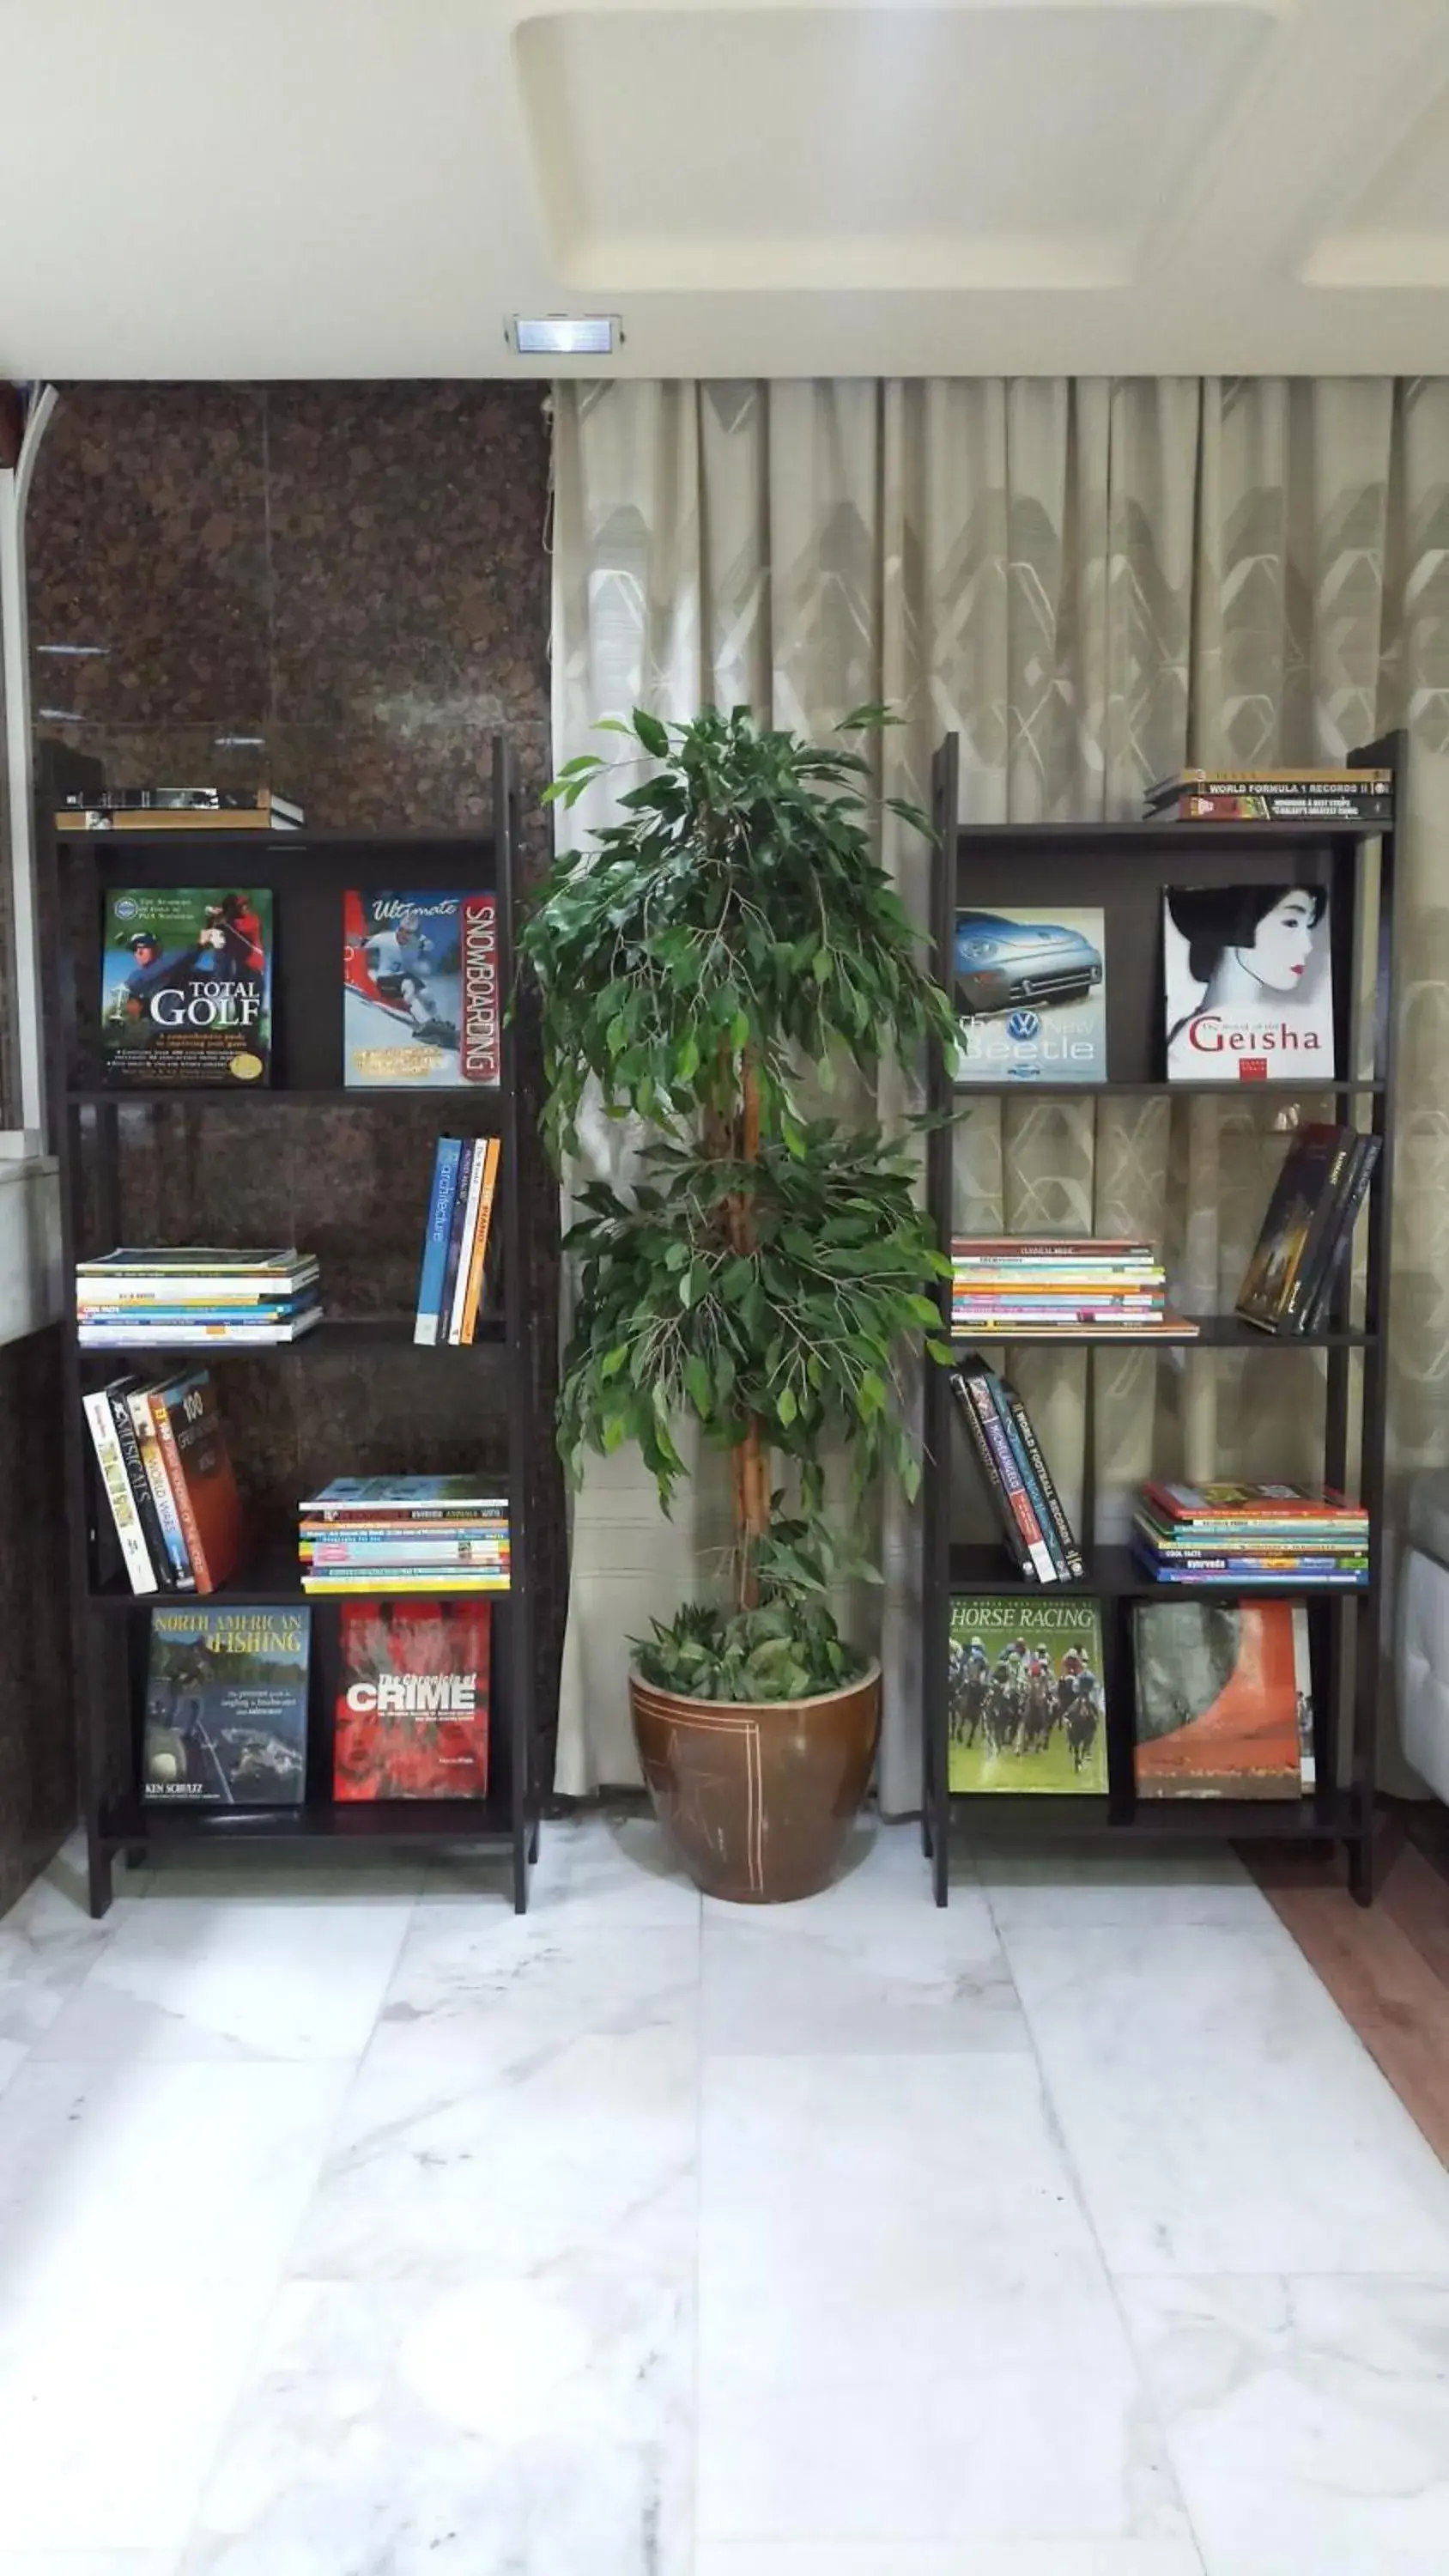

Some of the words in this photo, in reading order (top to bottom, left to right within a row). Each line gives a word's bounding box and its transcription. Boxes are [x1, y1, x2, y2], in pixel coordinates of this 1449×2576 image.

[1210, 783, 1246, 794] WORLD
[1249, 783, 1299, 793] FORMULA
[1301, 783, 1307, 793] 1
[1309, 782, 1357, 793] RECORDS
[373, 900, 460, 921] Ultimate
[189, 981, 259, 998] TOTAL
[466, 907, 495, 1070] SNOWBOARDING
[150, 988, 260, 1026] GOLF
[1041, 1015, 1095, 1035] New
[1189, 1017, 1322, 1051] Geisha
[959, 1036, 1094, 1060] Beetle
[432, 1164, 454, 1242] architecture
[114, 1417, 151, 1503] MUSICALS
[991, 1423, 1021, 1490] MICHELANGELO
[1016, 1412, 1035, 1448] WORLD
[1028, 1447, 1054, 1498] FOOTBALL
[1047, 1498, 1071, 1545] RECORDS
[155, 1614, 209, 1631] NORTH
[217, 1613, 301, 1631] AMERICAN
[951, 1608, 1015, 1626] HORSE
[1019, 1608, 1094, 1627] RACING
[207, 1631, 301, 1653] FISHING
[379, 1673, 400, 1686] The
[403, 1673, 461, 1685] Chronicle
[464, 1673, 476, 1686] of
[347, 1681, 475, 1711] CRIME
[145, 1783, 164, 1794] KEN
